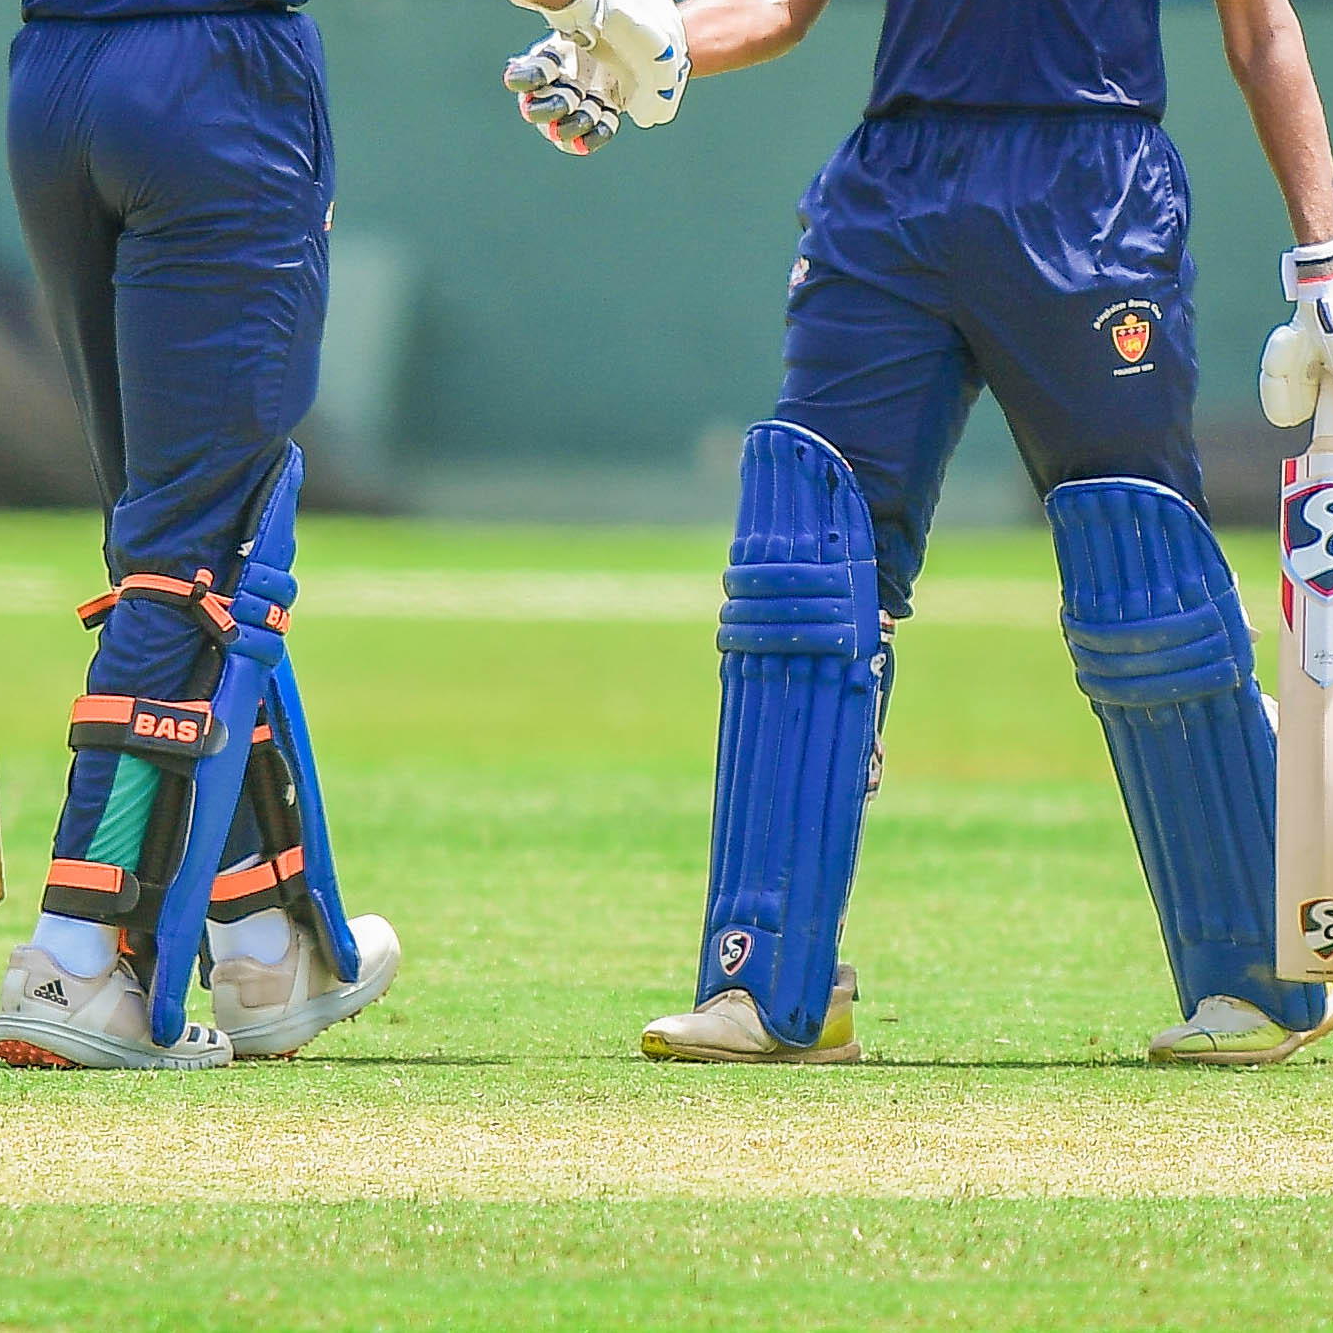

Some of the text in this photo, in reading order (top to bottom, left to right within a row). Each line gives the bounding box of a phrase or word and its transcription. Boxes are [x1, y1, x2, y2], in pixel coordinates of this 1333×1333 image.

[266, 604, 291, 633] BA
[133, 713, 198, 743] BAS
[721, 934, 744, 966] SG
[33, 989, 68, 1007] adidas
